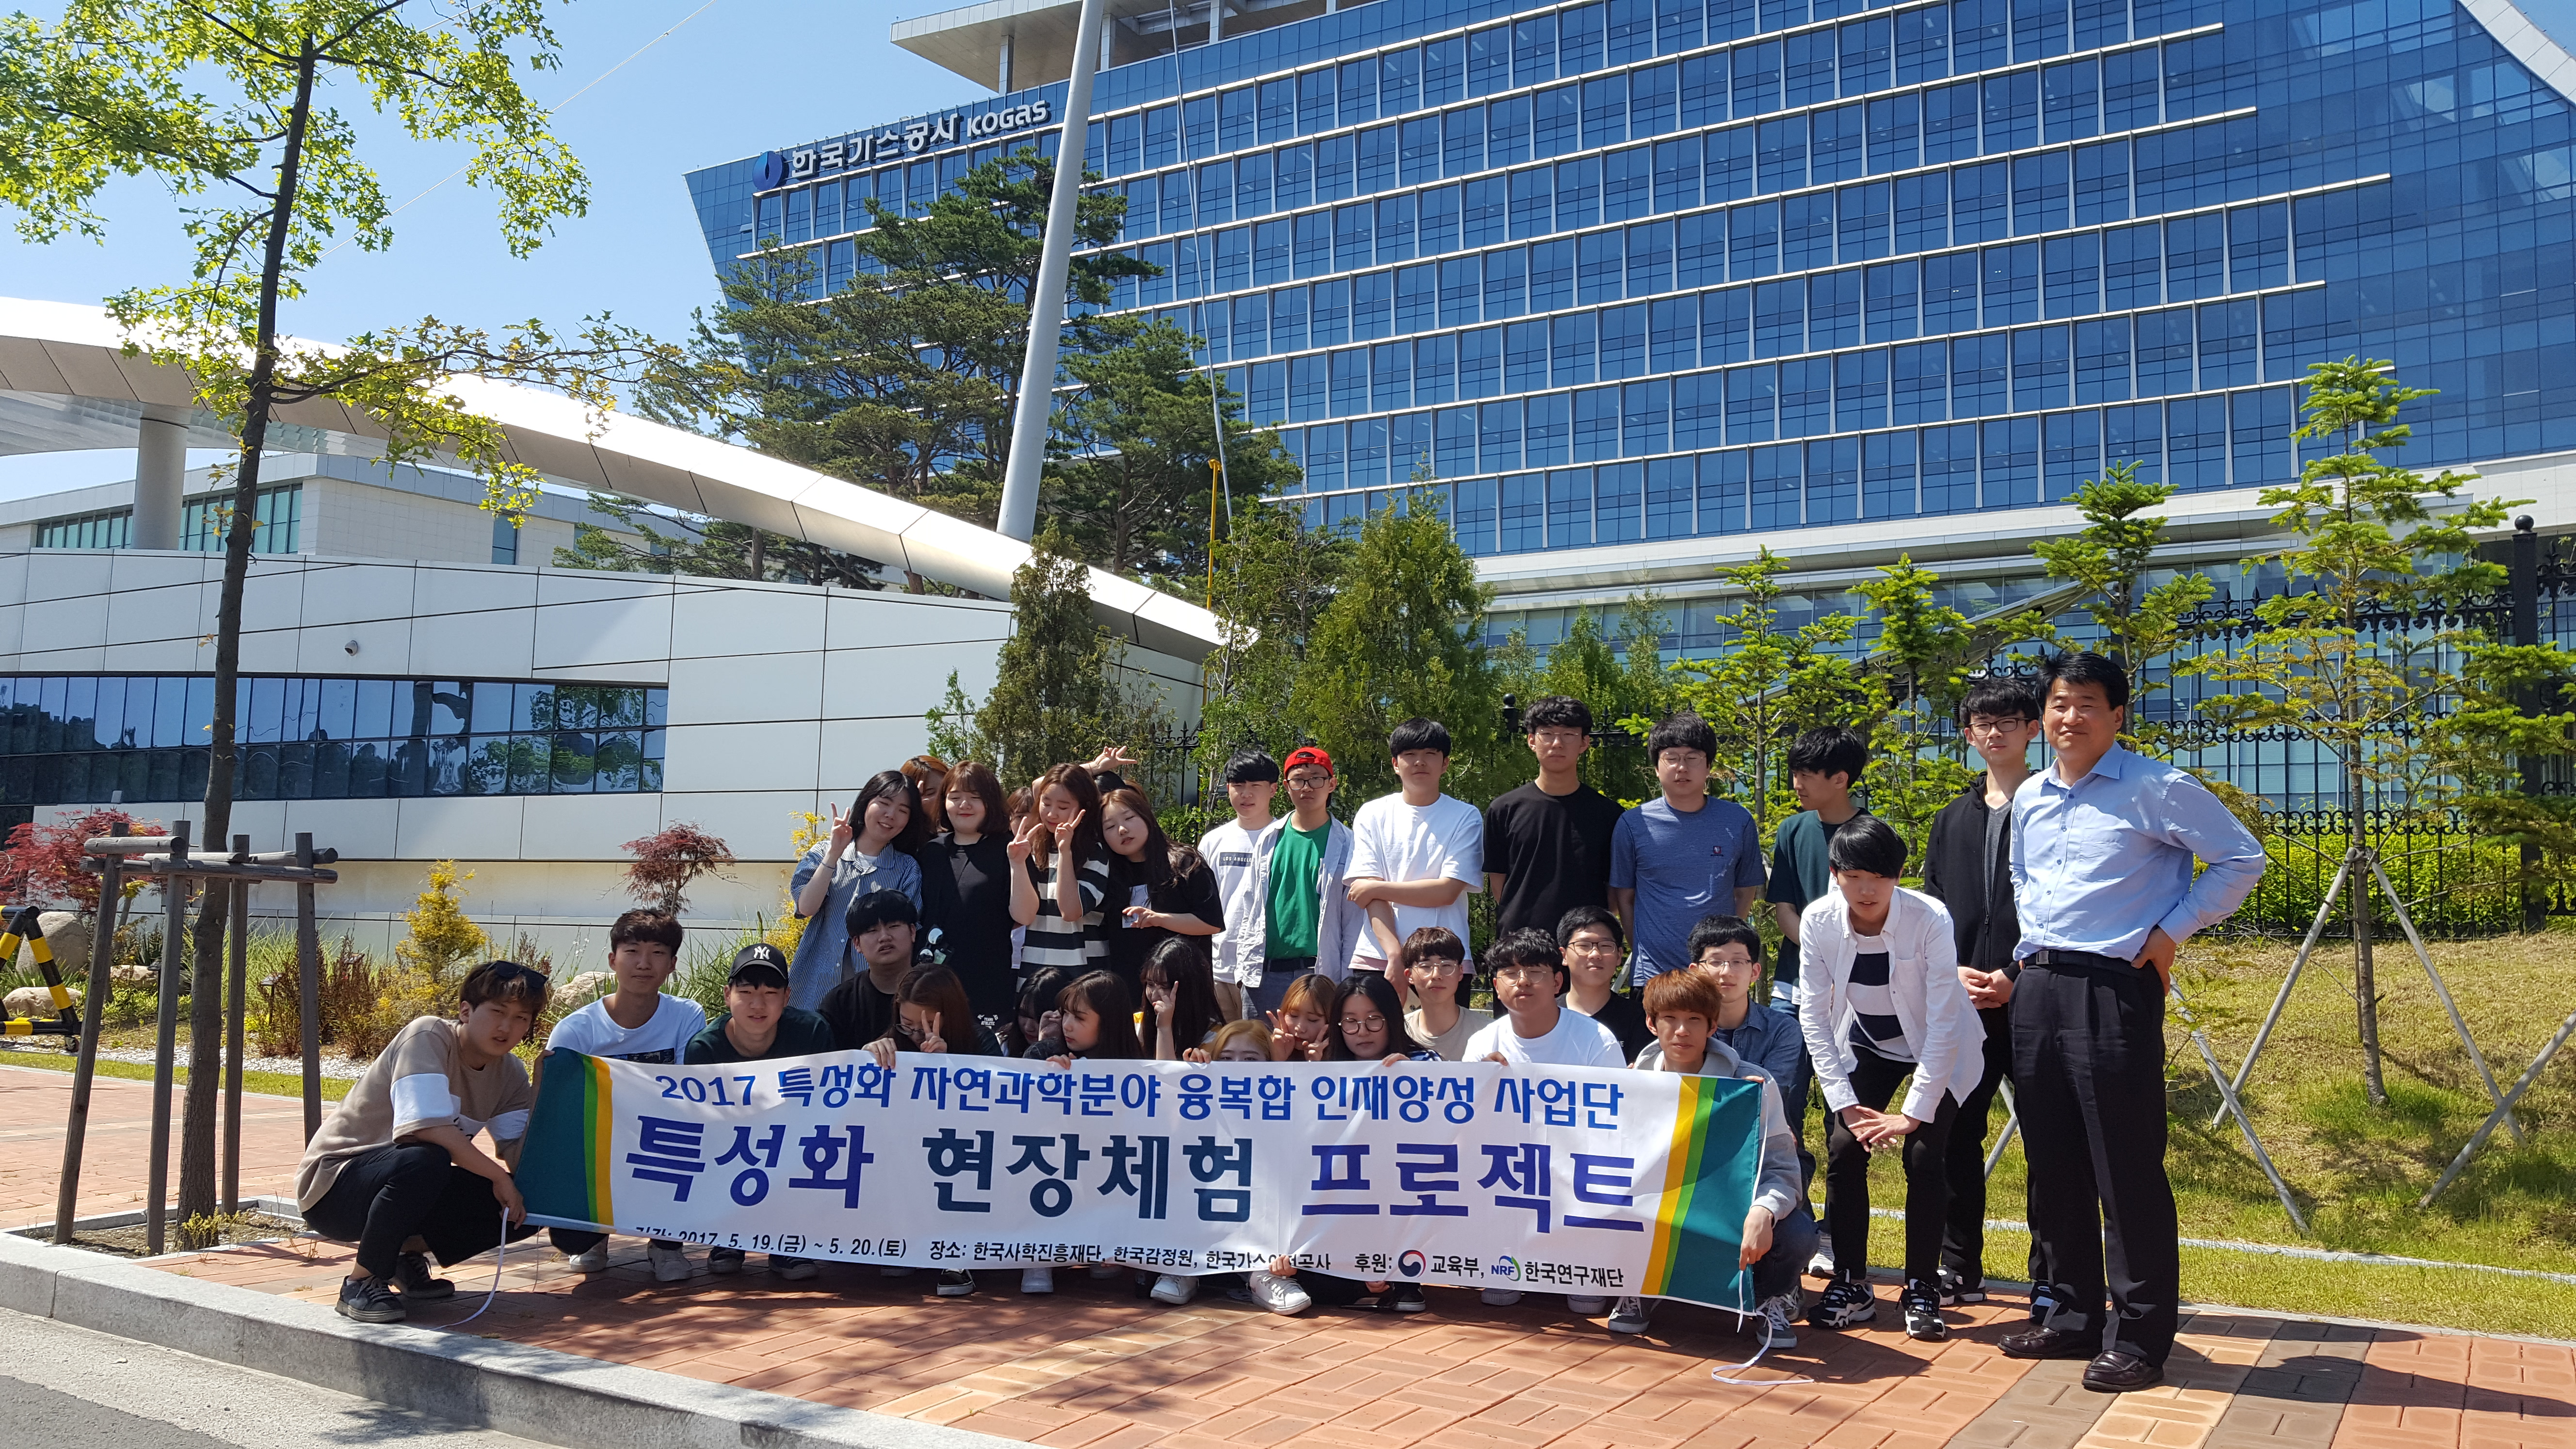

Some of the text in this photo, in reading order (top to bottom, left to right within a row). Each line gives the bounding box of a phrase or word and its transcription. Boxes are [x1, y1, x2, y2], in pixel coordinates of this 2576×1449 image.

[791, 113, 958, 178] 한국가스공사
[656, 1063, 1624, 1129] 2017 특성화 자연과학분야 융복합 인재양성 사업단
[626, 1116, 1644, 1233] 특성화 현장체험 프로젝트
[930, 1241, 966, 1260] 장소:
[1114, 1247, 1197, 1269] 한국감정원,
[1355, 1254, 1392, 1272] 후원:
[1431, 1256, 1483, 1278] 교육부,
[1491, 1264, 1515, 1276] NRF
[1525, 1262, 1624, 1287] 한국연구재단
